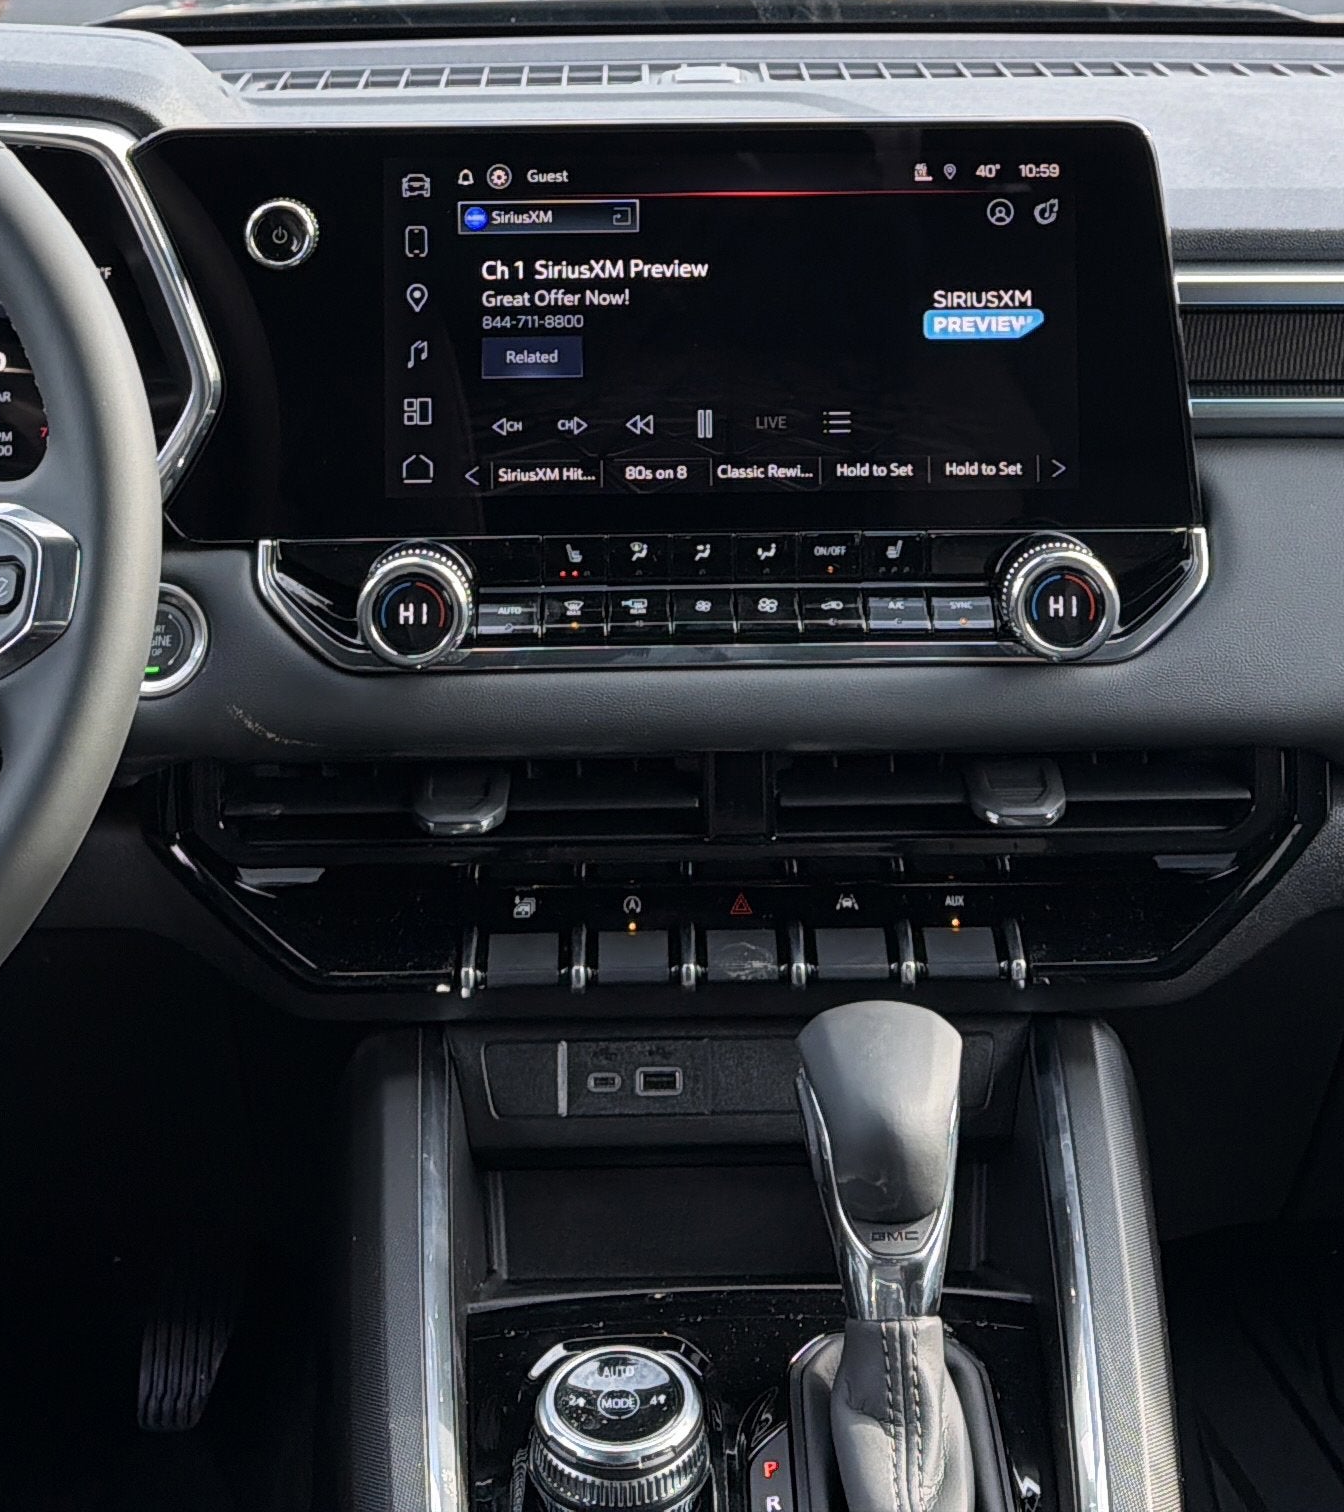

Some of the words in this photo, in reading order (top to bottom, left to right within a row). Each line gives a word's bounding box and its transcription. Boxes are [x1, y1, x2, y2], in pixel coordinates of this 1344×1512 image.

[527, 169, 569, 185] Guest
[975, 163, 1001, 178] 40°
[1018, 164, 1060, 178] 10:59
[491, 210, 553, 225] SiriusXM
[481, 260, 509, 280] Ch
[514, 261, 524, 279] 1
[535, 260, 624, 280] SiriusXM
[629, 259, 709, 278] Preview
[482, 290, 531, 309] Great
[534, 289, 582, 308] Offer
[585, 289, 630, 307] Now!
[932, 290, 1033, 308] SIRIUSXM
[482, 314, 584, 330] 844-711-8800
[932, 316, 1034, 333] PREVIEW
[505, 350, 558, 364] Related
[507, 420, 523, 432] CH
[558, 419, 573, 431] CH
[755, 416, 788, 429] LIVE
[40, 426, 49, 438] 7
[498, 467, 559, 482] SiriusXM
[562, 467, 596, 481] Hit...
[625, 467, 653, 480] 80s
[656, 470, 673, 480] on
[677, 467, 688, 479] 8
[717, 465, 765, 479] Classic
[768, 464, 814, 479] Rewi...
[836, 463, 870, 477] Hold
[873, 465, 887, 477] to
[890, 463, 914, 477] Set
[945, 462, 979, 476] Hold
[981, 463, 996, 476] to
[999, 462, 1023, 475] Set
[813, 545, 847, 557] ON/OFF
[497, 606, 523, 615] AUTO
[887, 600, 905, 610] A/C
[949, 600, 973, 610] SYNC
[1048, 595, 1078, 617] HI
[398, 602, 428, 625] HI
[945, 895, 965, 908] AUX
[871, 1230, 919, 1242] GMC
[602, 1365, 636, 1380] AUTO
[600, 1397, 636, 1409] MODE
[763, 1460, 780, 1479] P
[765, 1495, 783, 1512] R
